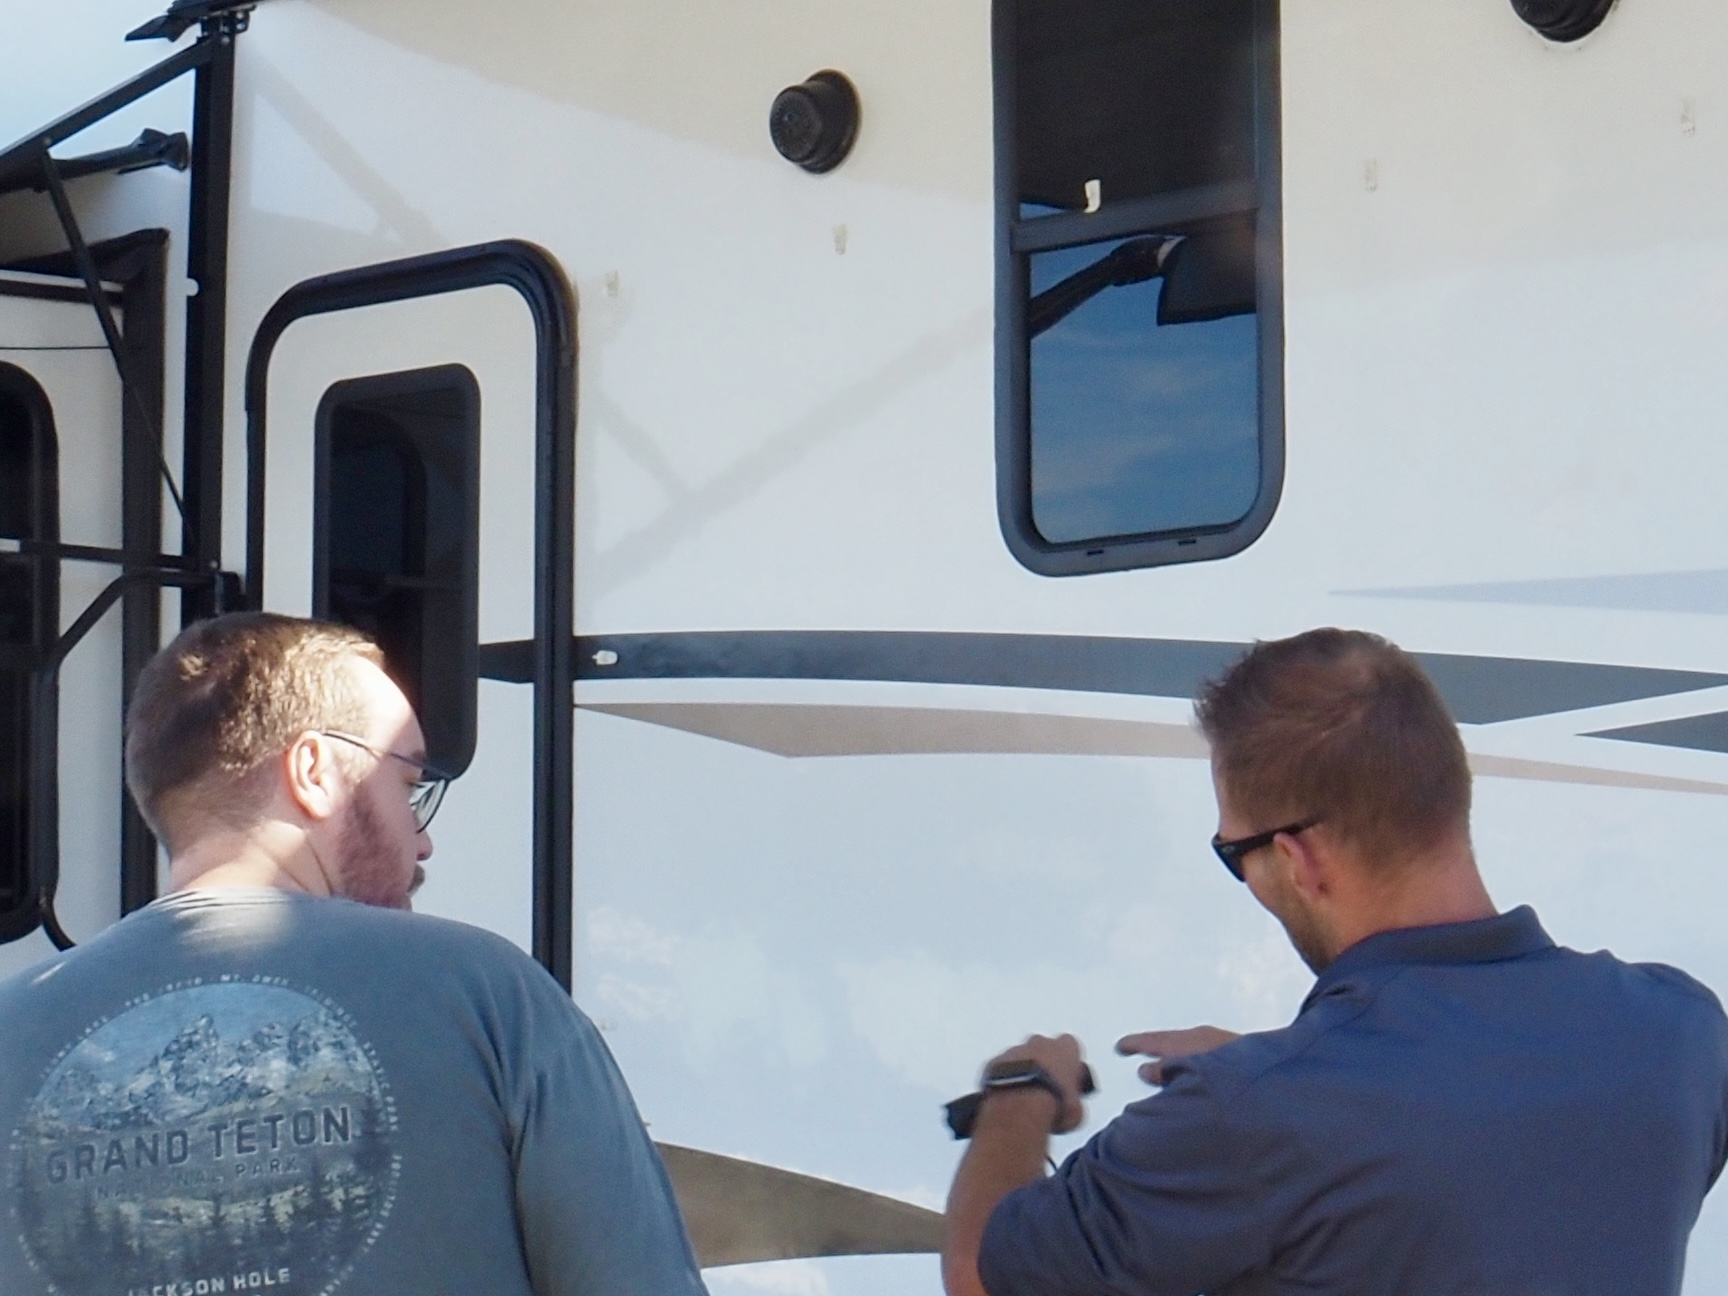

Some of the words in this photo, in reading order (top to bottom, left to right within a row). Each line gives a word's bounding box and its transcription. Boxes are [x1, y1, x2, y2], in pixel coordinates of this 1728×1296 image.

[47, 1128, 189, 1184] GRAND
[207, 1106, 351, 1159] TETON
[97, 1170, 222, 1198] NANAL
[234, 1157, 299, 1177] PARK
[232, 1267, 291, 1290] HOLE
